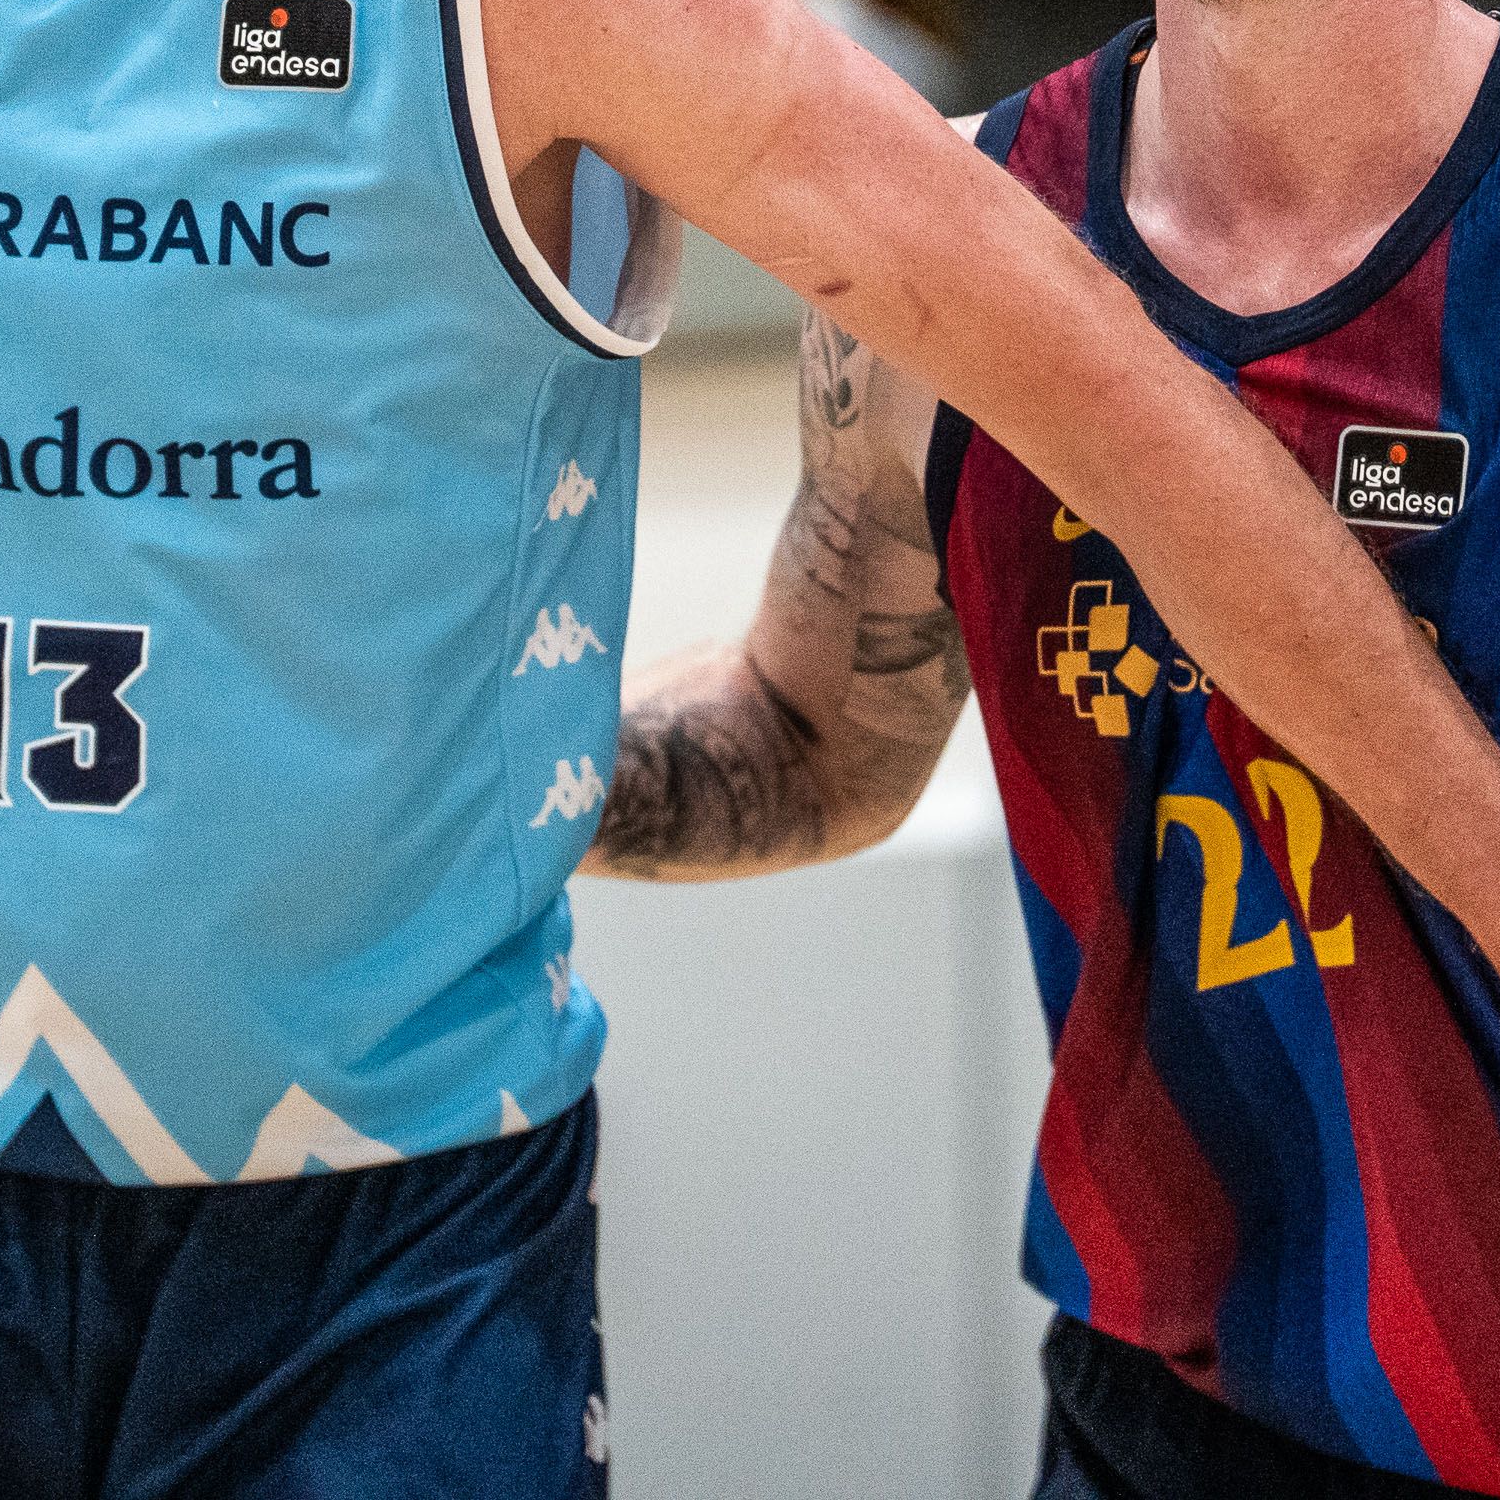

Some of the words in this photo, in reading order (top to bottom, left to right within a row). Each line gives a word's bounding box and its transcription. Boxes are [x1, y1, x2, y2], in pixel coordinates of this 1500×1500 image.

[232, 22, 282, 52] liga
[231, 50, 340, 78] endesa
[1351, 457, 1401, 487] liga
[1349, 487, 1454, 516] endesa
[1156, 758, 1356, 992] 22
